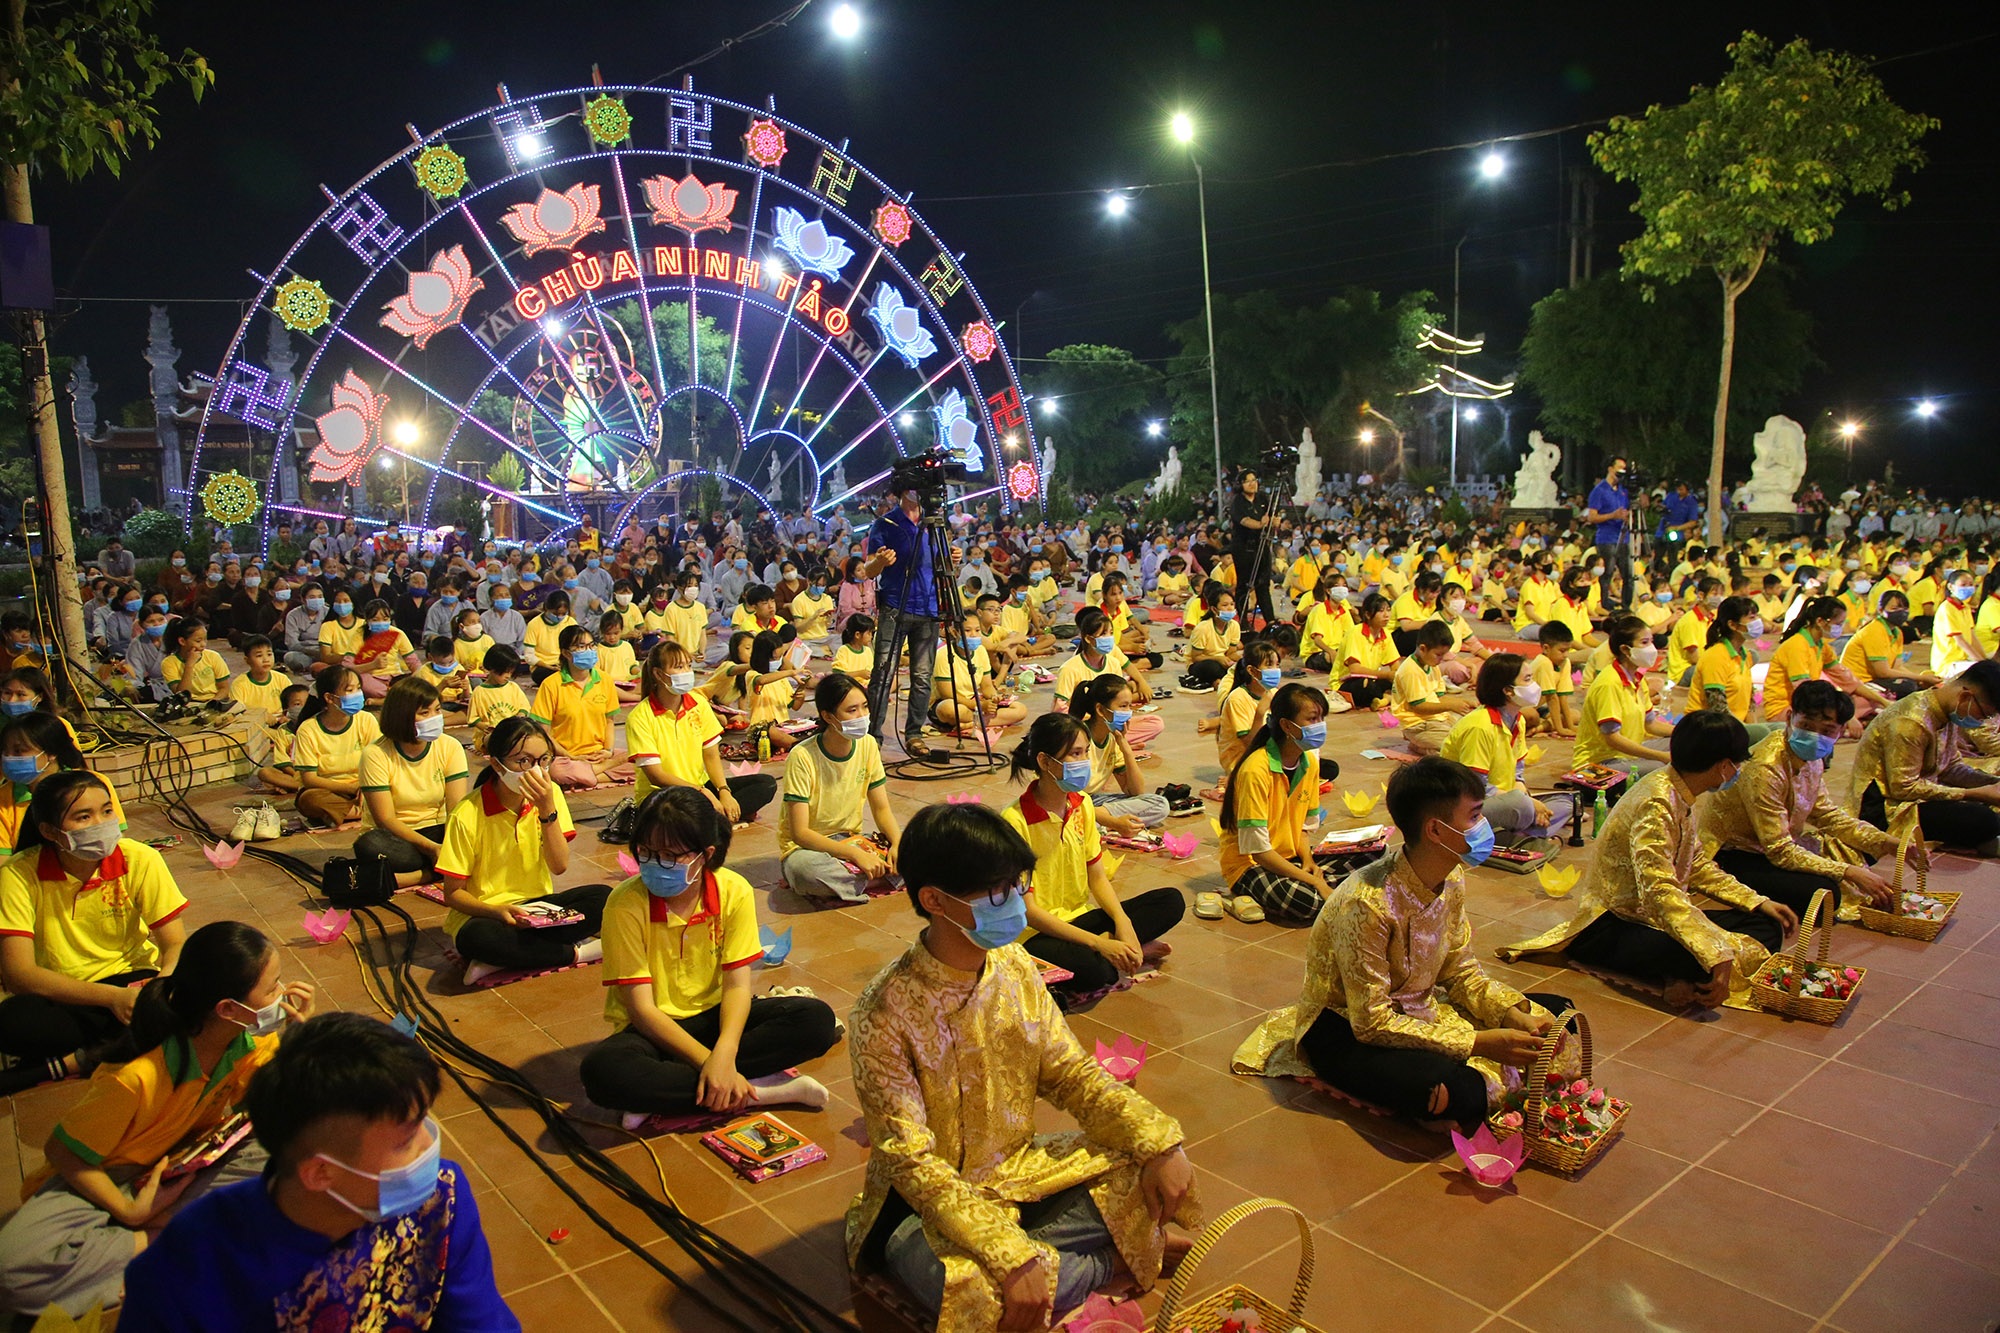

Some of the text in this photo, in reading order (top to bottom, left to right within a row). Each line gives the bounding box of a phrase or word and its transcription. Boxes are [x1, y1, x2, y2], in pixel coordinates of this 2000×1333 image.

[515, 246, 849, 336] CHÙA NINH TẢO
